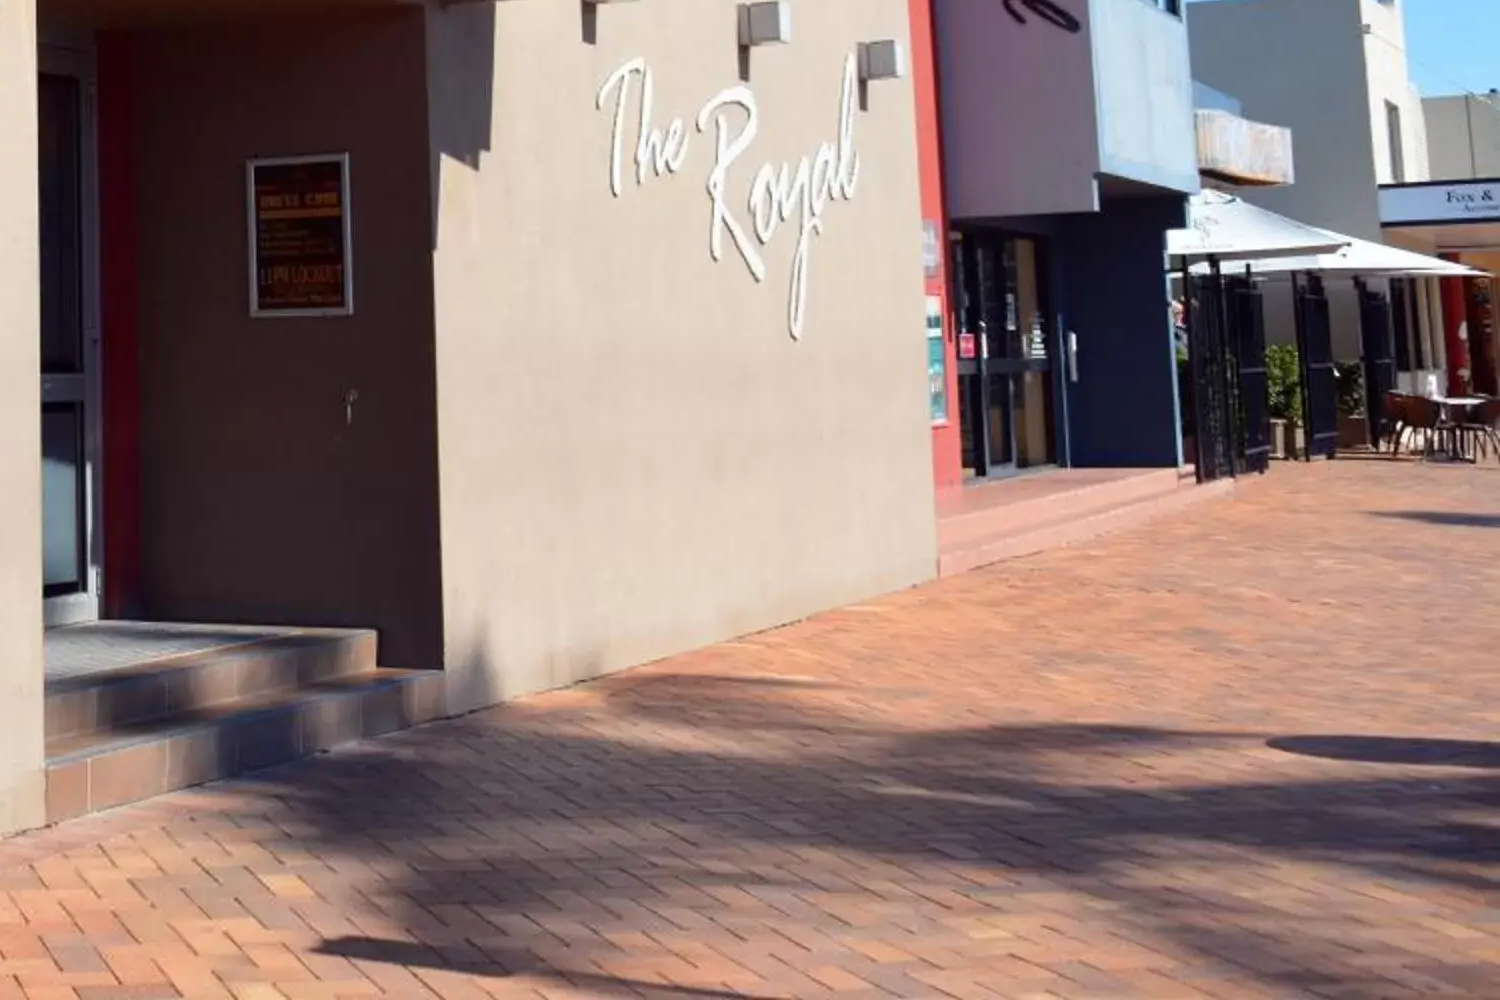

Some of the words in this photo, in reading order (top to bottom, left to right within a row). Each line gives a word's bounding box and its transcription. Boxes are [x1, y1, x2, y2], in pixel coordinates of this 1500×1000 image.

[596, 55, 690, 198] The
[696, 51, 859, 342] Royal
[1481, 188, 1493, 201] &
